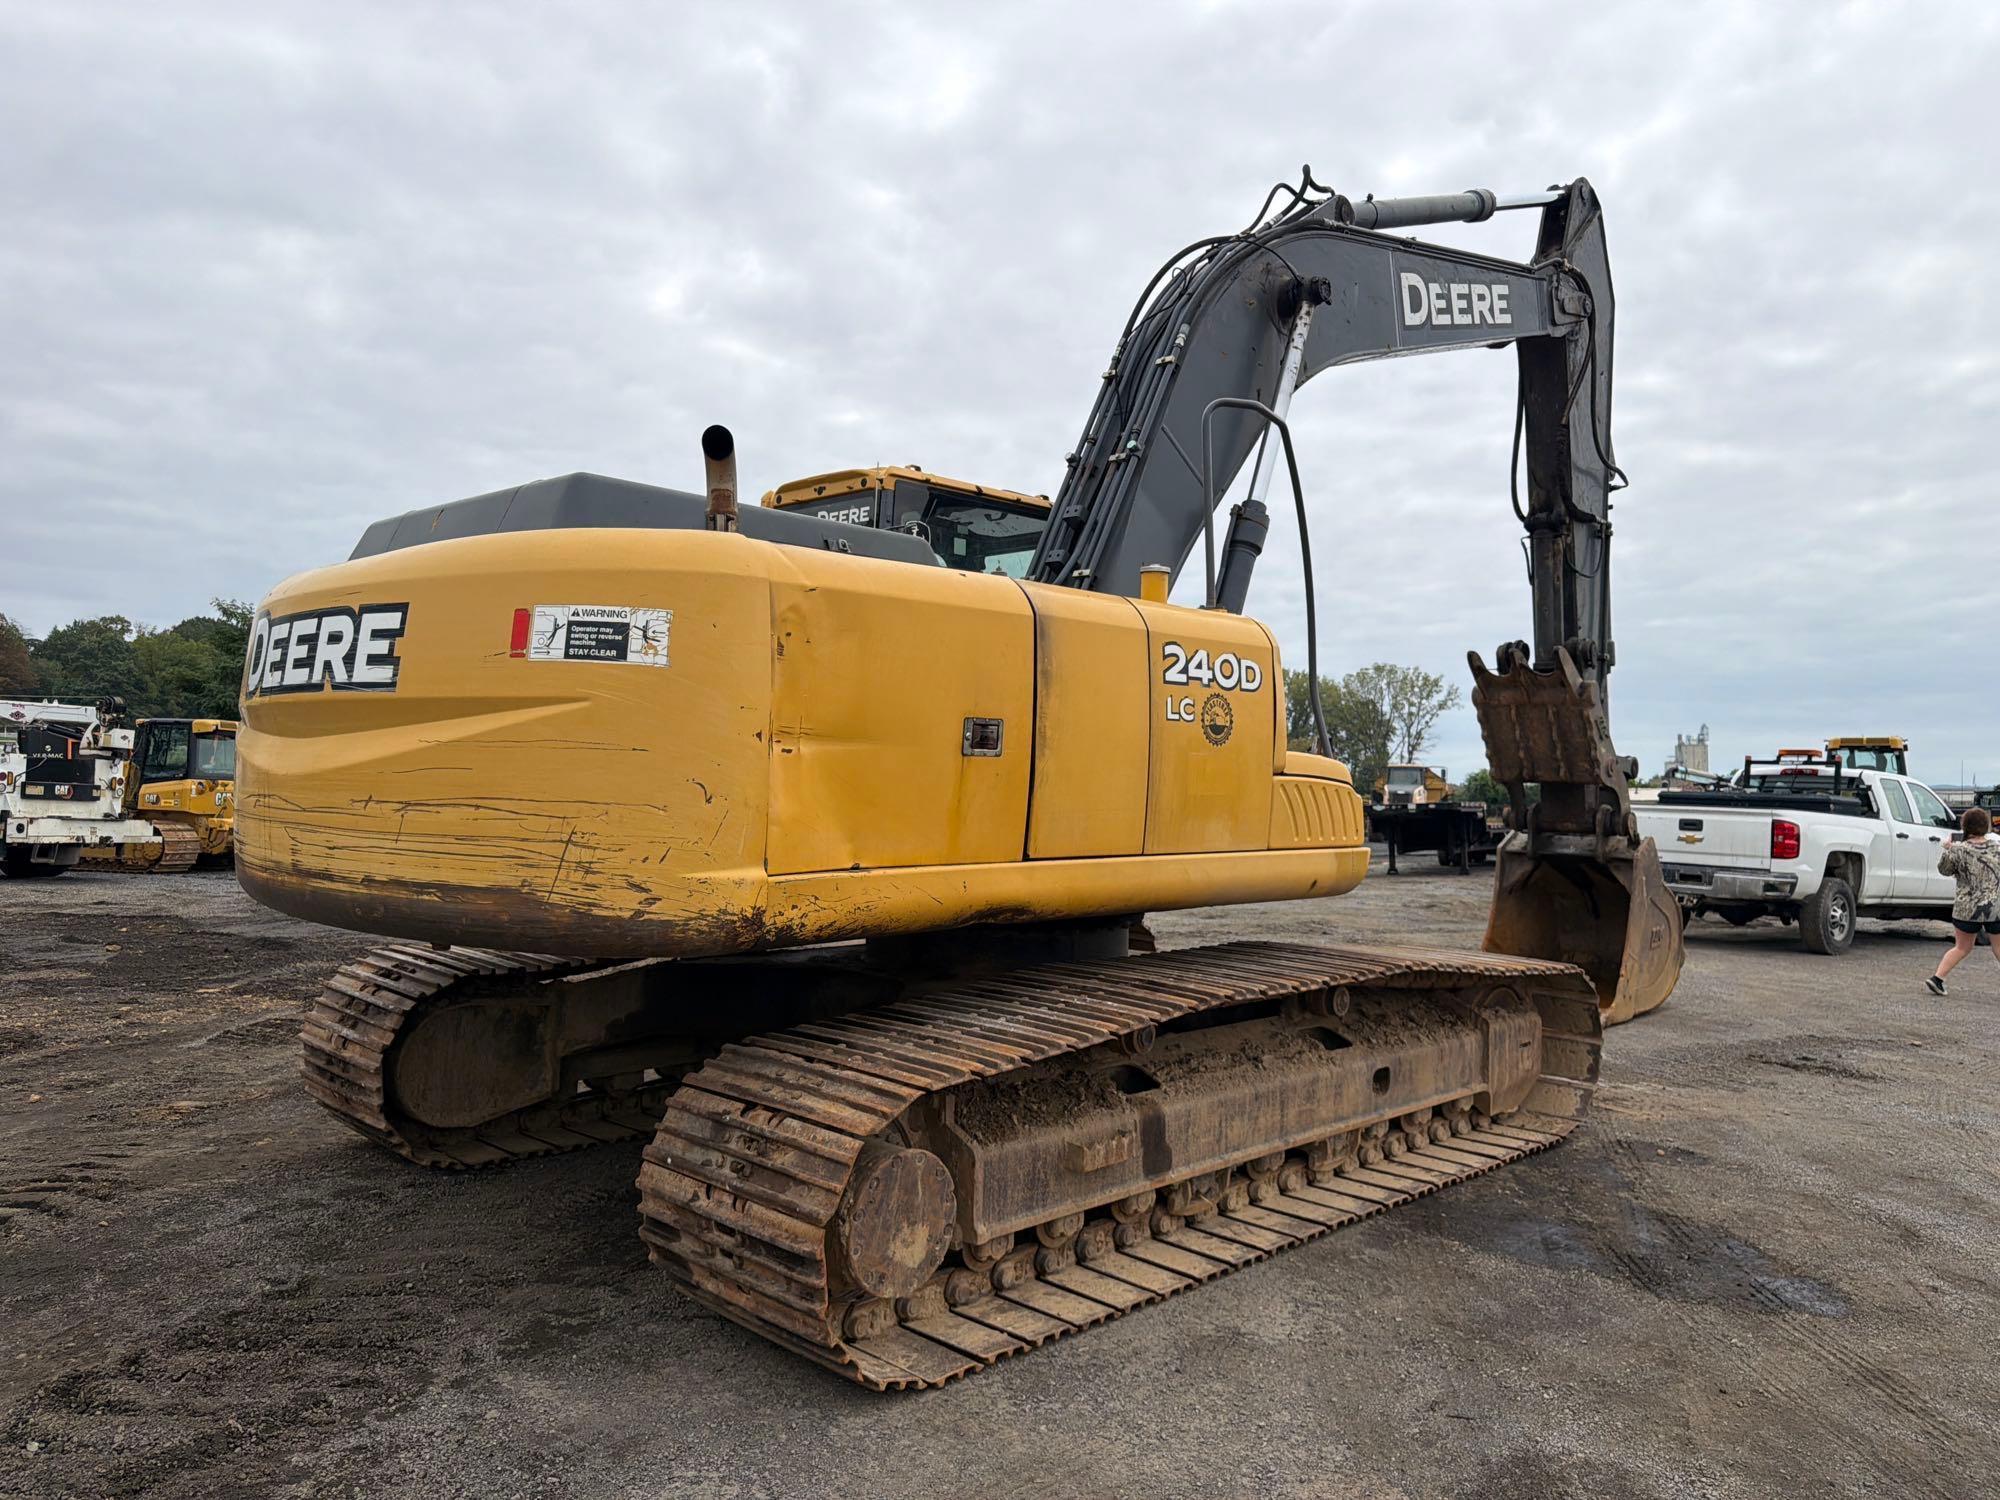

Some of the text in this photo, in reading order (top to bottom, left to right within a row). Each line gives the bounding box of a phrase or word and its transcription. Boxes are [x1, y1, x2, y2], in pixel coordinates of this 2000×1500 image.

[1400, 272, 1512, 326] DEERE
[581, 608, 627, 619] WARNING
[571, 625, 598, 633] Operator
[248, 611, 403, 691] DEERE
[569, 648, 617, 657] STAY CLEAR
[1163, 644, 1262, 690] 240D
[1167, 696, 1195, 721] LC
[54, 784, 70, 795] CAT
[145, 794, 158, 803] CAT
